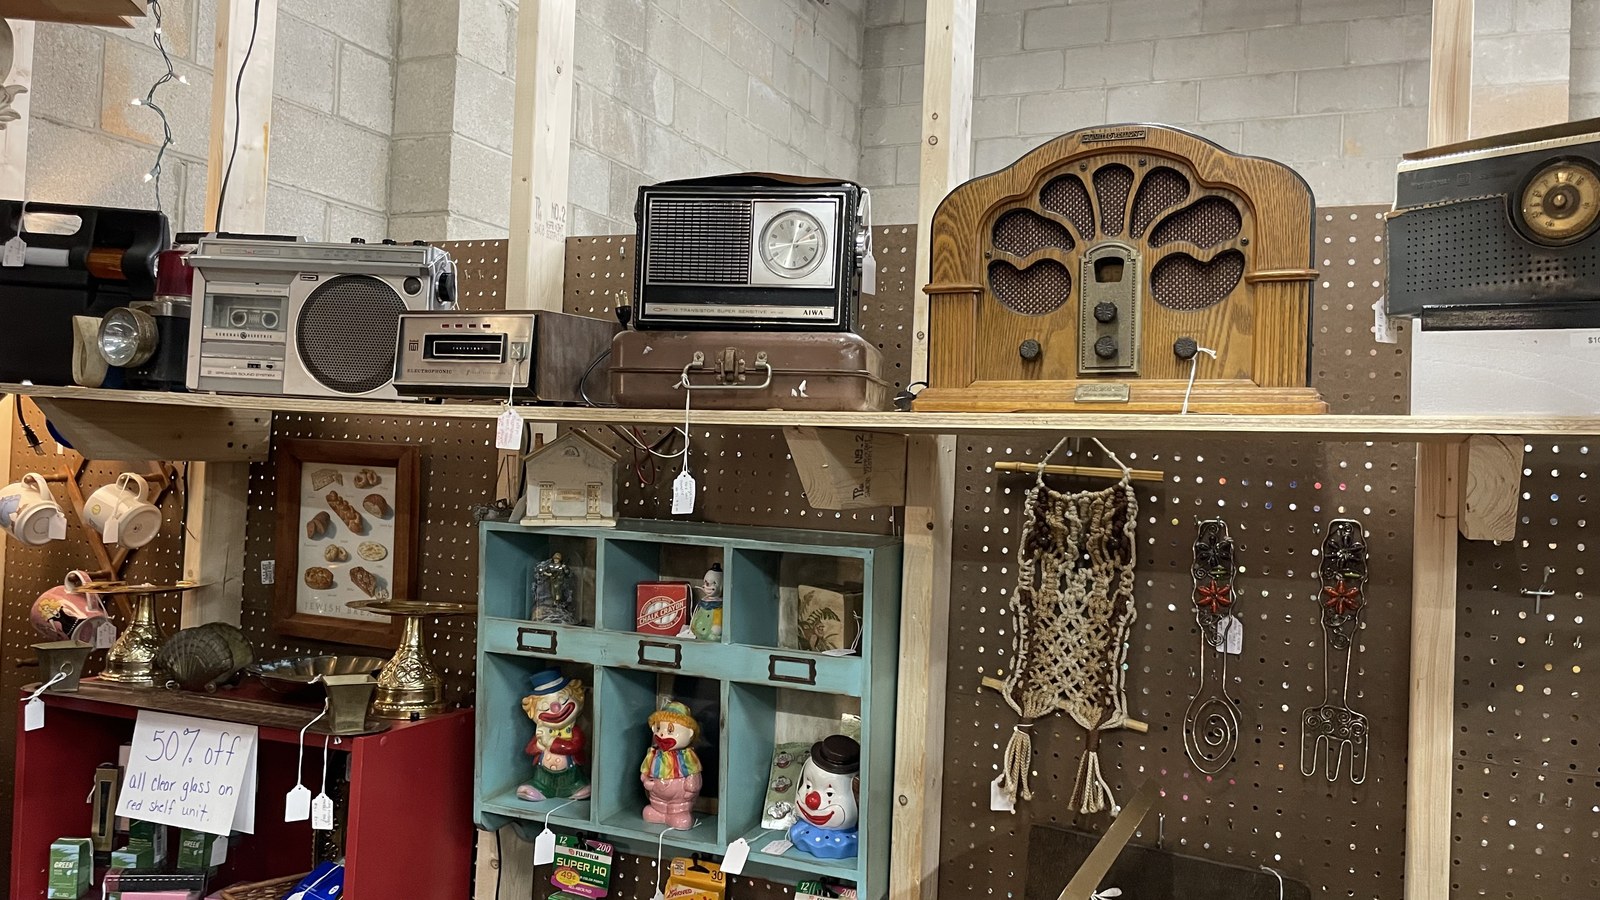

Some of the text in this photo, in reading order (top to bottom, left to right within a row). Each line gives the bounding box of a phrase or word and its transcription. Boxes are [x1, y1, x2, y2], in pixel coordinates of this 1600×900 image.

[304, 601, 341, 614] JEWISH
[640, 611, 659, 624] CHALK
[660, 601, 684, 616] CRAYON
[145, 728, 242, 767] 50% off
[128, 771, 234, 802] all clear glass on
[126, 798, 142, 811] red
[148, 799, 176, 815] shelf
[184, 840, 200, 848] GREEN
[560, 836, 568, 844] 12
[596, 843, 612, 854] 200
[576, 850, 599, 860] FUJIFILM
[556, 857, 607, 878] SUPER HQ
[711, 870, 723, 881] 30
[801, 882, 810, 890] 12
[840, 888, 856, 898] 200
